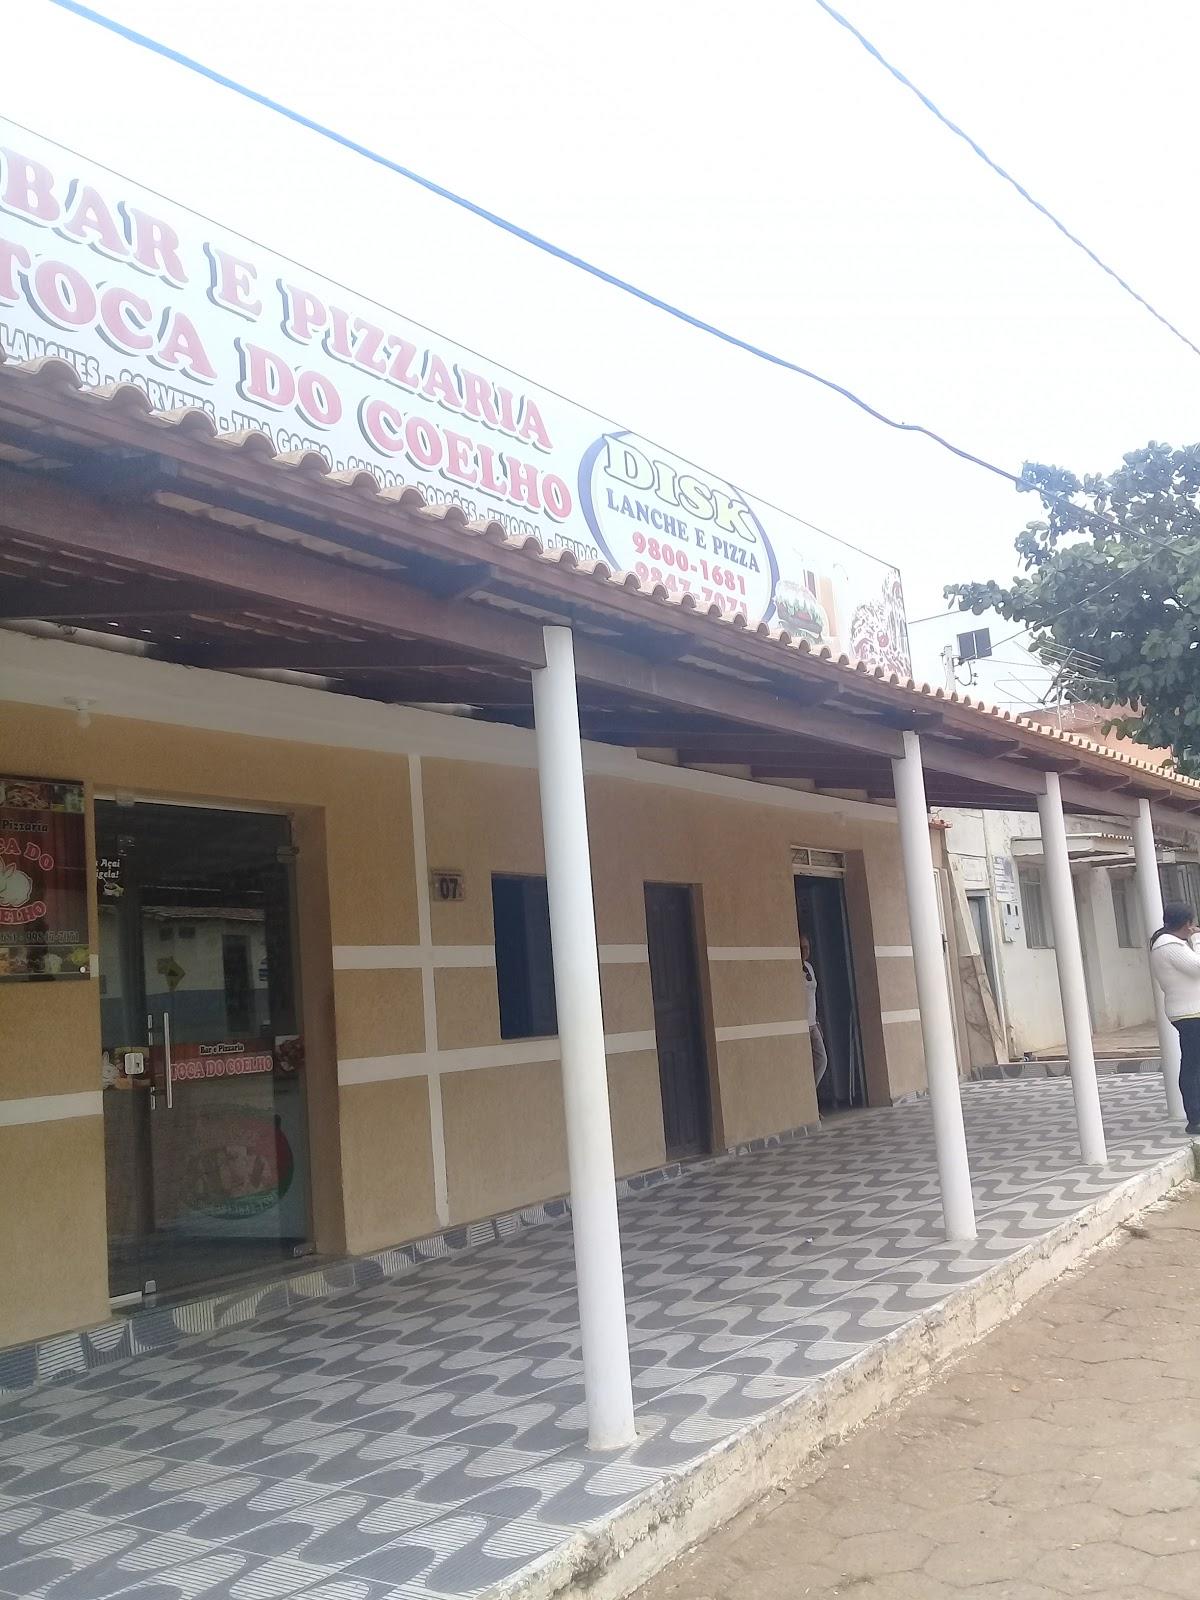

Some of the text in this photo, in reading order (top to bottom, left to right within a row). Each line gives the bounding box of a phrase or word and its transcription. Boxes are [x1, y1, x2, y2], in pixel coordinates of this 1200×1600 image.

[0, 147, 553, 452] BAR E PIZZARIA
[0, 239, 573, 522] TOCA DO COELHO
[602, 433, 757, 543] DISK
[606, 487, 761, 574] LANCHE E PIZZA
[631, 531, 747, 596] 9800-1681
[440, 877, 459, 899] 07
[206, 1059, 225, 1077] DO
[226, 1055, 273, 1076] COELHO
